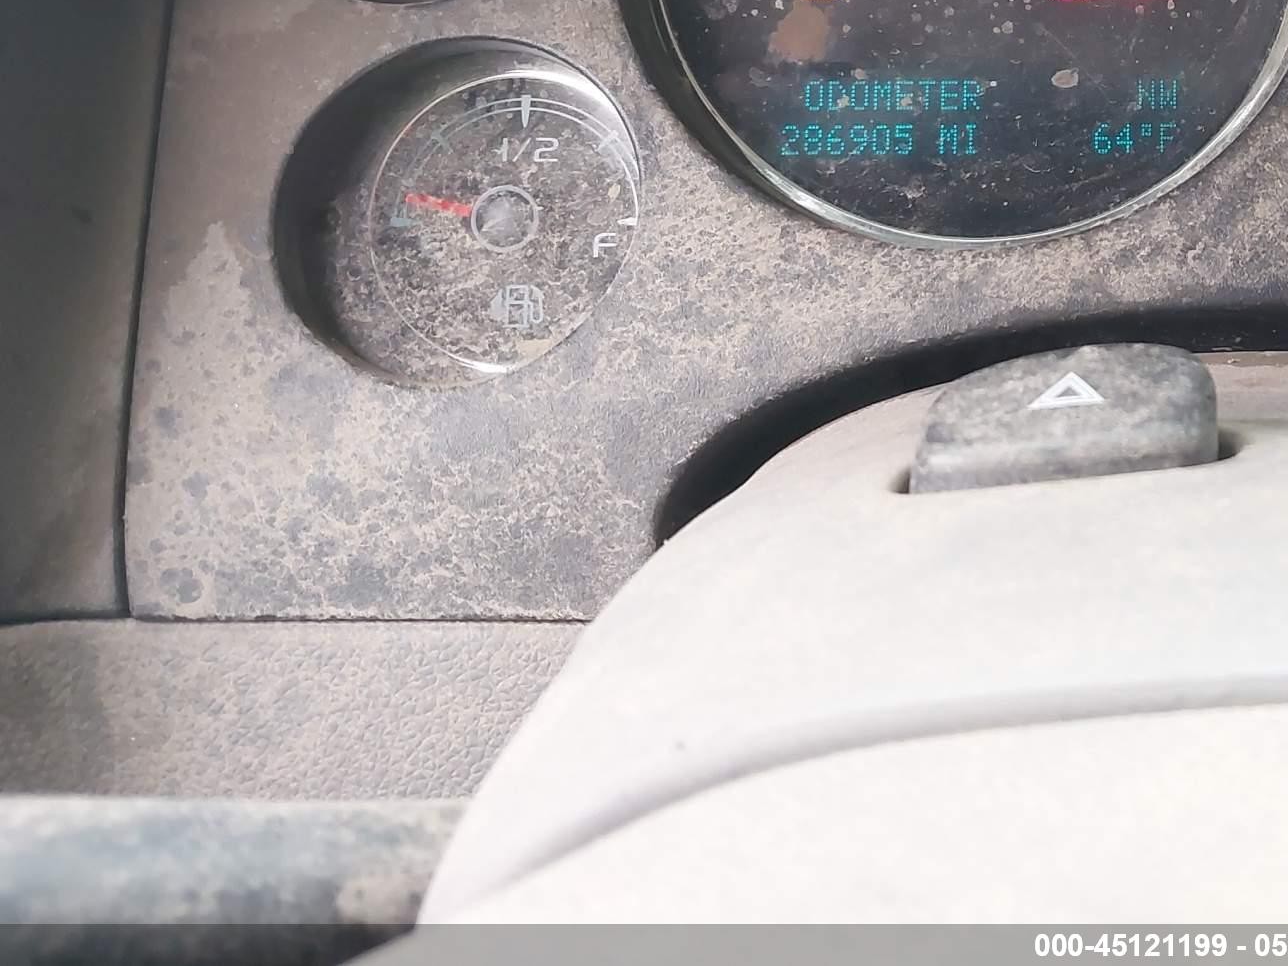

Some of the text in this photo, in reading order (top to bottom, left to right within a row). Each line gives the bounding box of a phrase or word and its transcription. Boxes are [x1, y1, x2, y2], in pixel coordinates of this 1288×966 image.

[804, 80, 981, 111] ODOMETER
[1136, 79, 1177, 109] NW
[500, 138, 559, 161] 1/2
[781, 124, 977, 155] 286905 MI
[593, 233, 617, 257] F
